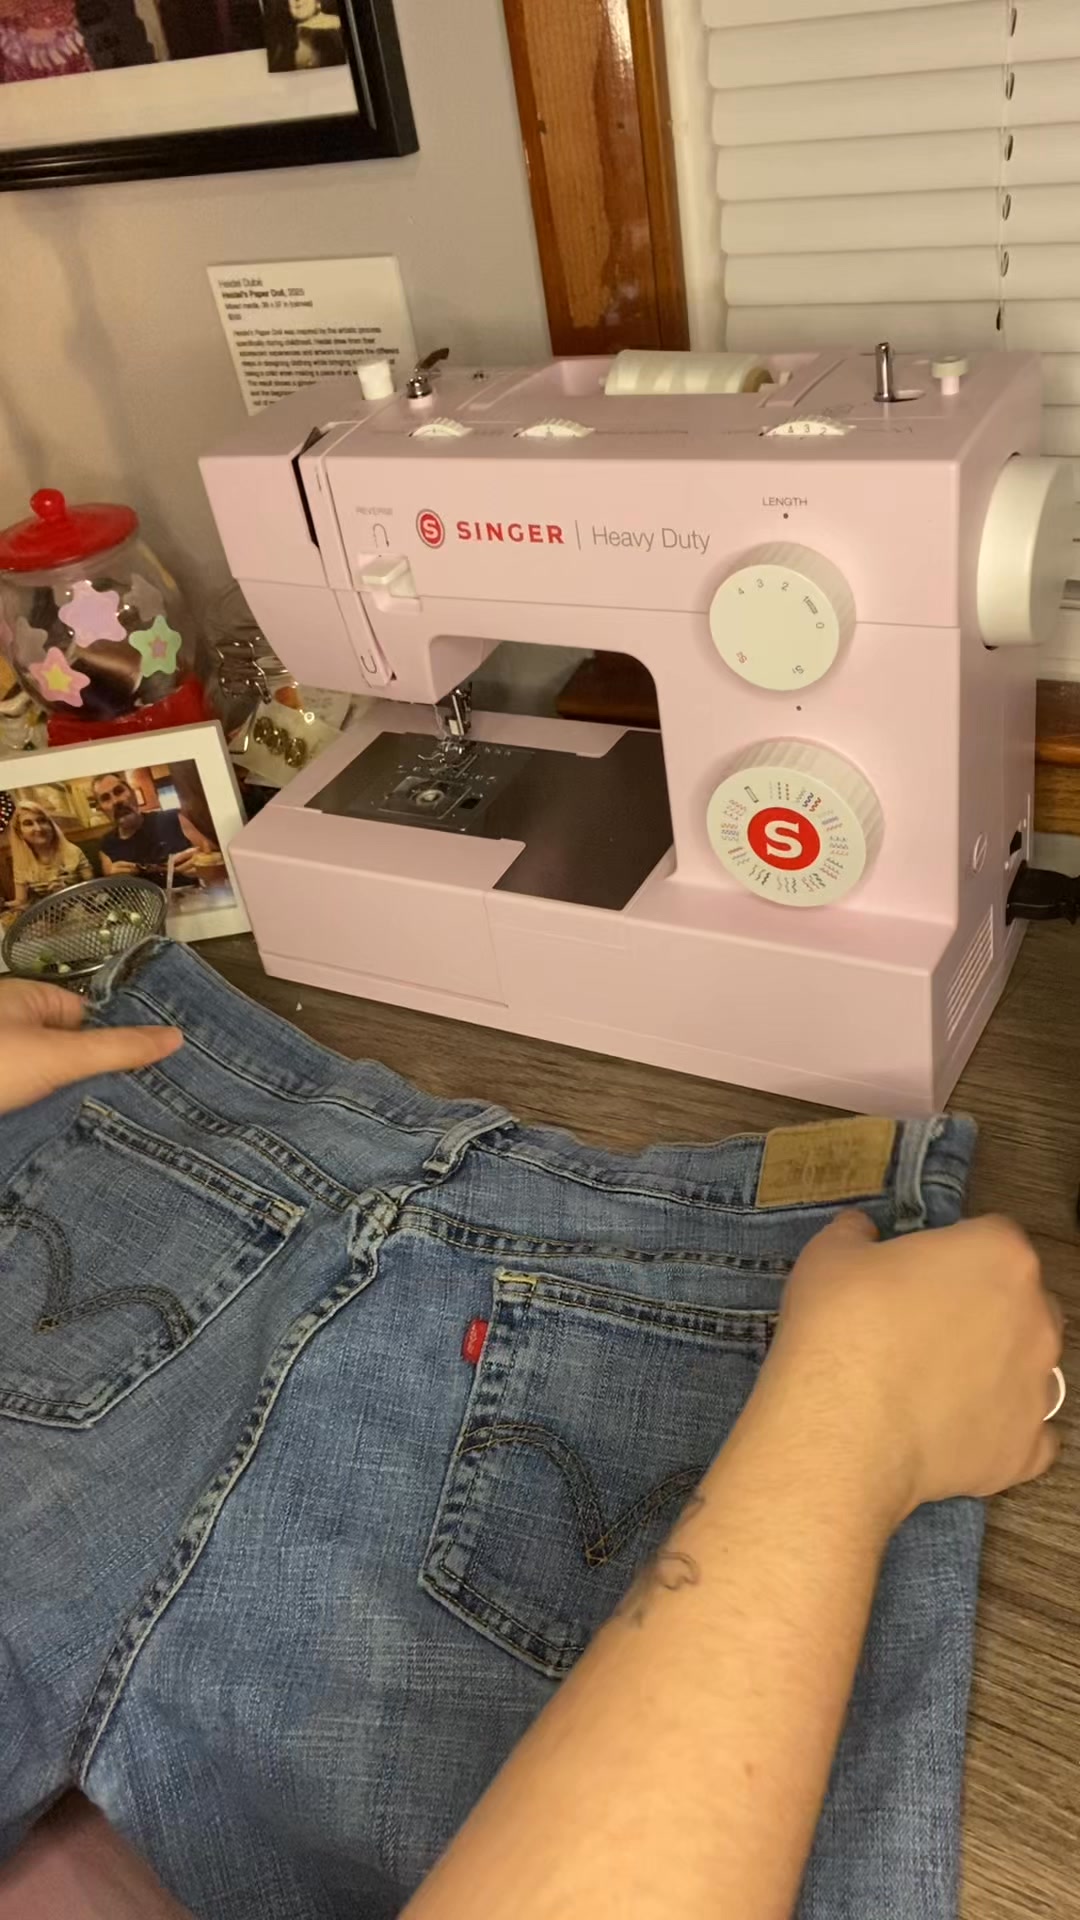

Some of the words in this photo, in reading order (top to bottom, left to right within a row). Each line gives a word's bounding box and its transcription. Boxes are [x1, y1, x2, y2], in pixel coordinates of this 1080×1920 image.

[762, 497, 808, 506] LENGTH
[456, 520, 565, 544] SINGER
[592, 525, 655, 552] Heavy
[661, 527, 711, 554] Duty
[738, 587, 745, 595] 4
[756, 578, 764, 589] 3
[781, 581, 789, 591] 2
[763, 820, 803, 859] S
